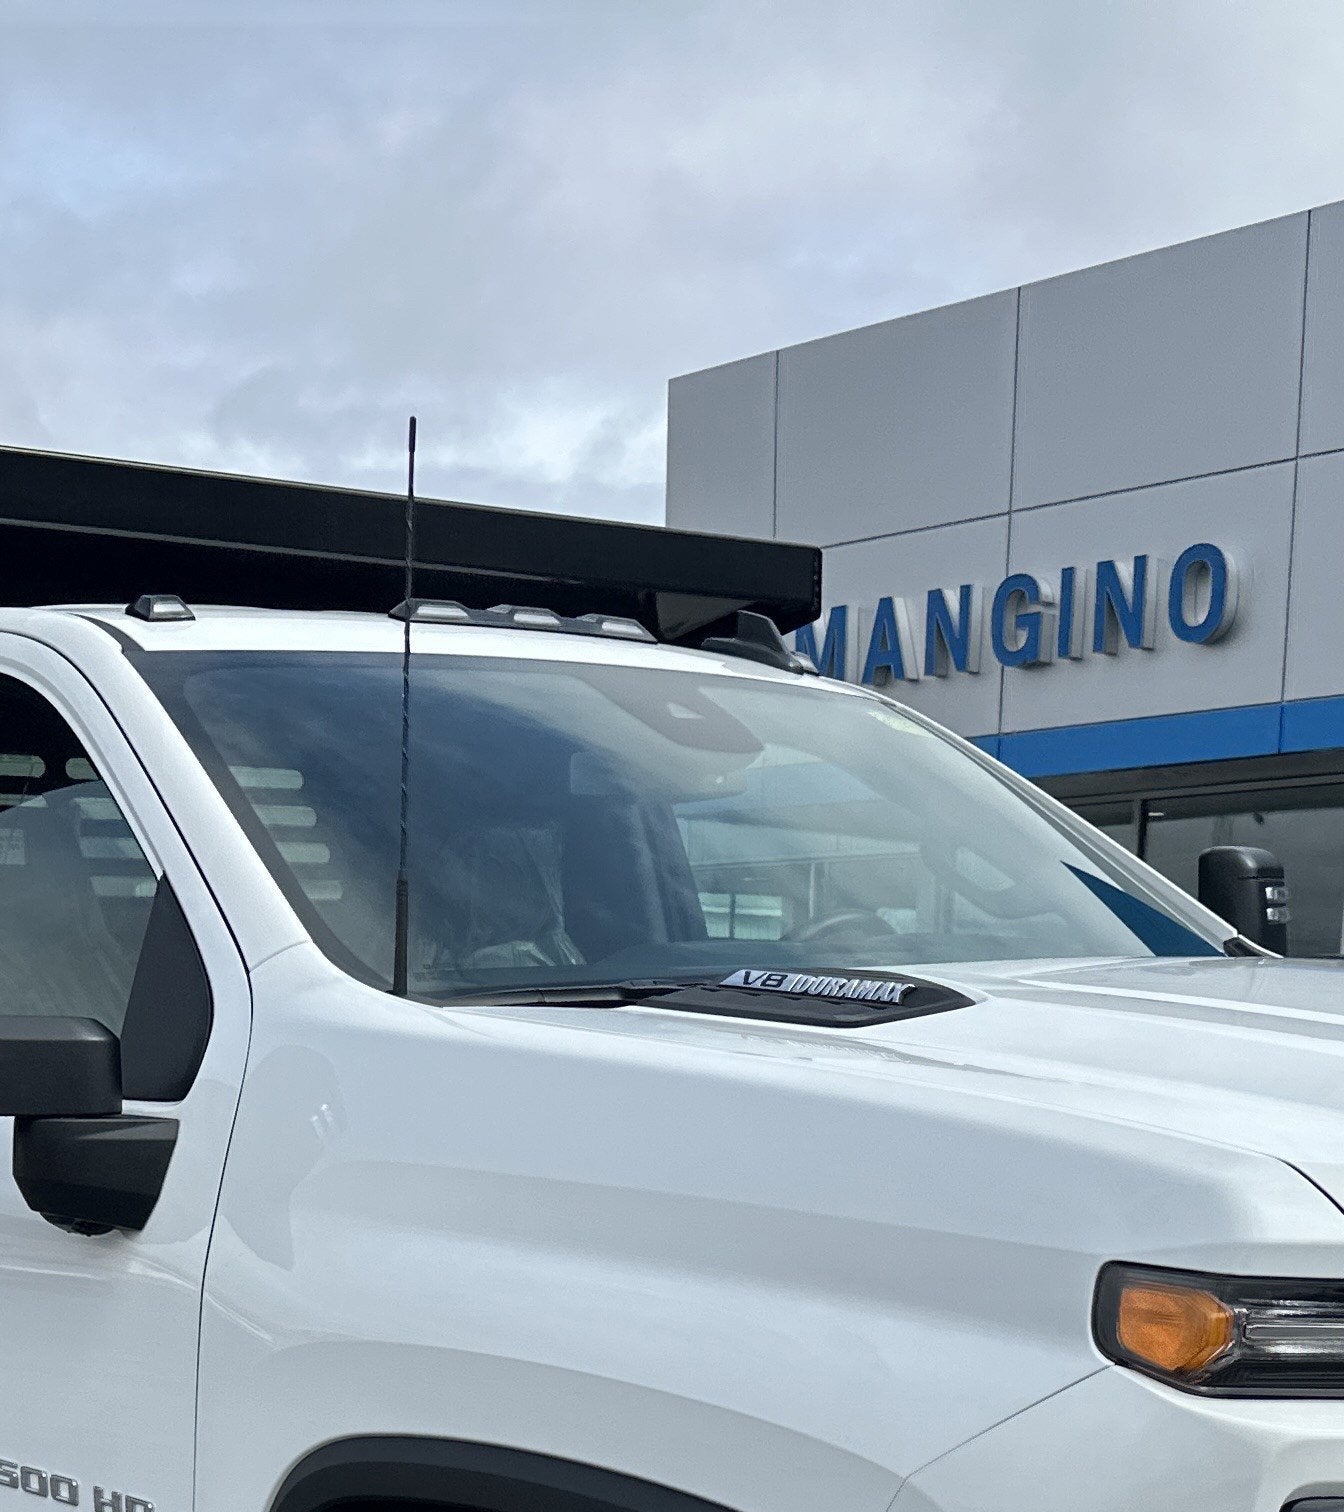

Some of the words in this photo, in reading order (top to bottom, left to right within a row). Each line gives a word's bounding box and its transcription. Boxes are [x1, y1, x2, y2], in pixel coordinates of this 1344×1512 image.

[795, 543, 1228, 685] MANGINO
[743, 970, 788, 988] V8
[794, 973, 910, 1003] DURAMAX
